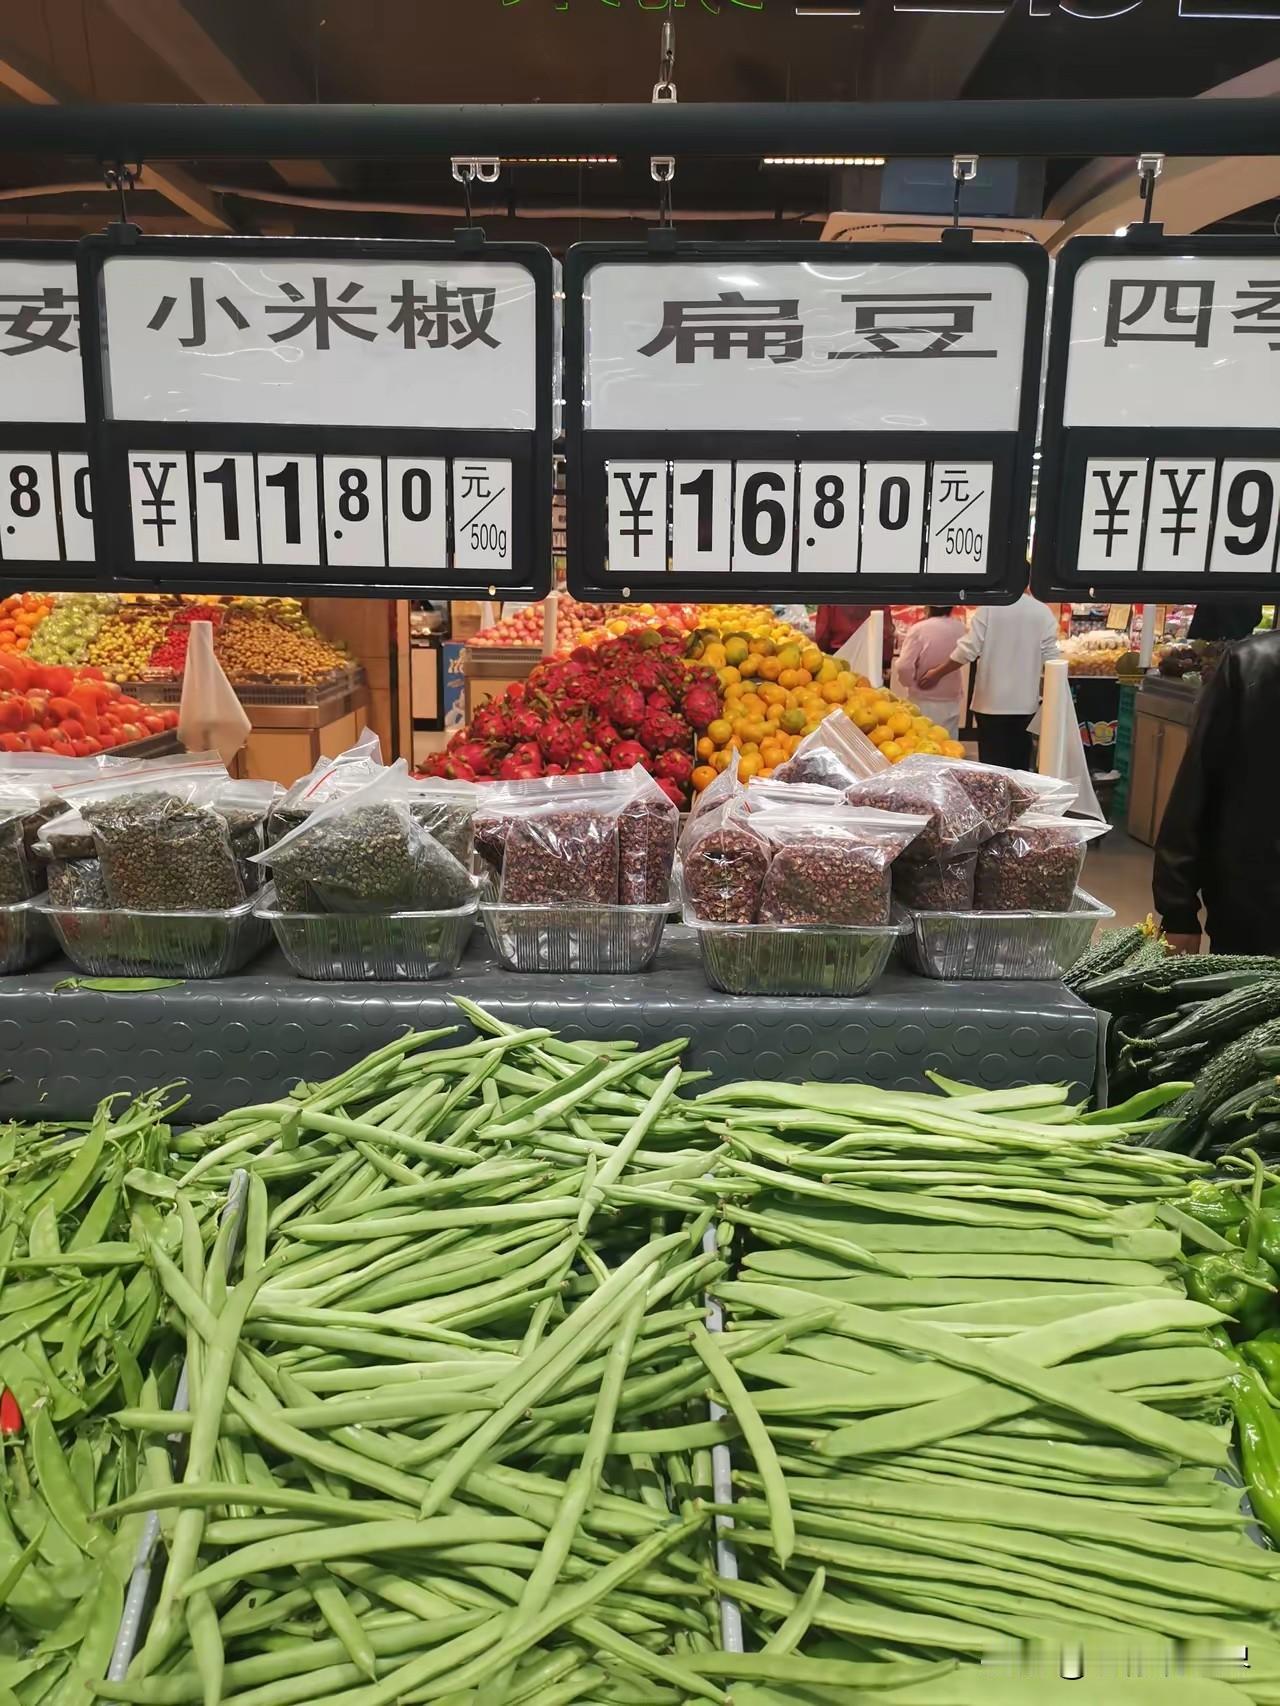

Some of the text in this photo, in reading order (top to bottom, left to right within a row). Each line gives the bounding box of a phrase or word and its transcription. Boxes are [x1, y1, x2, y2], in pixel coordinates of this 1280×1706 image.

[147, 277, 502, 351] 小米椒
[637, 291, 998, 364] 扁豆
[133, 457, 431, 547] ¥11.80
[612, 469, 911, 558] ¥16.80
